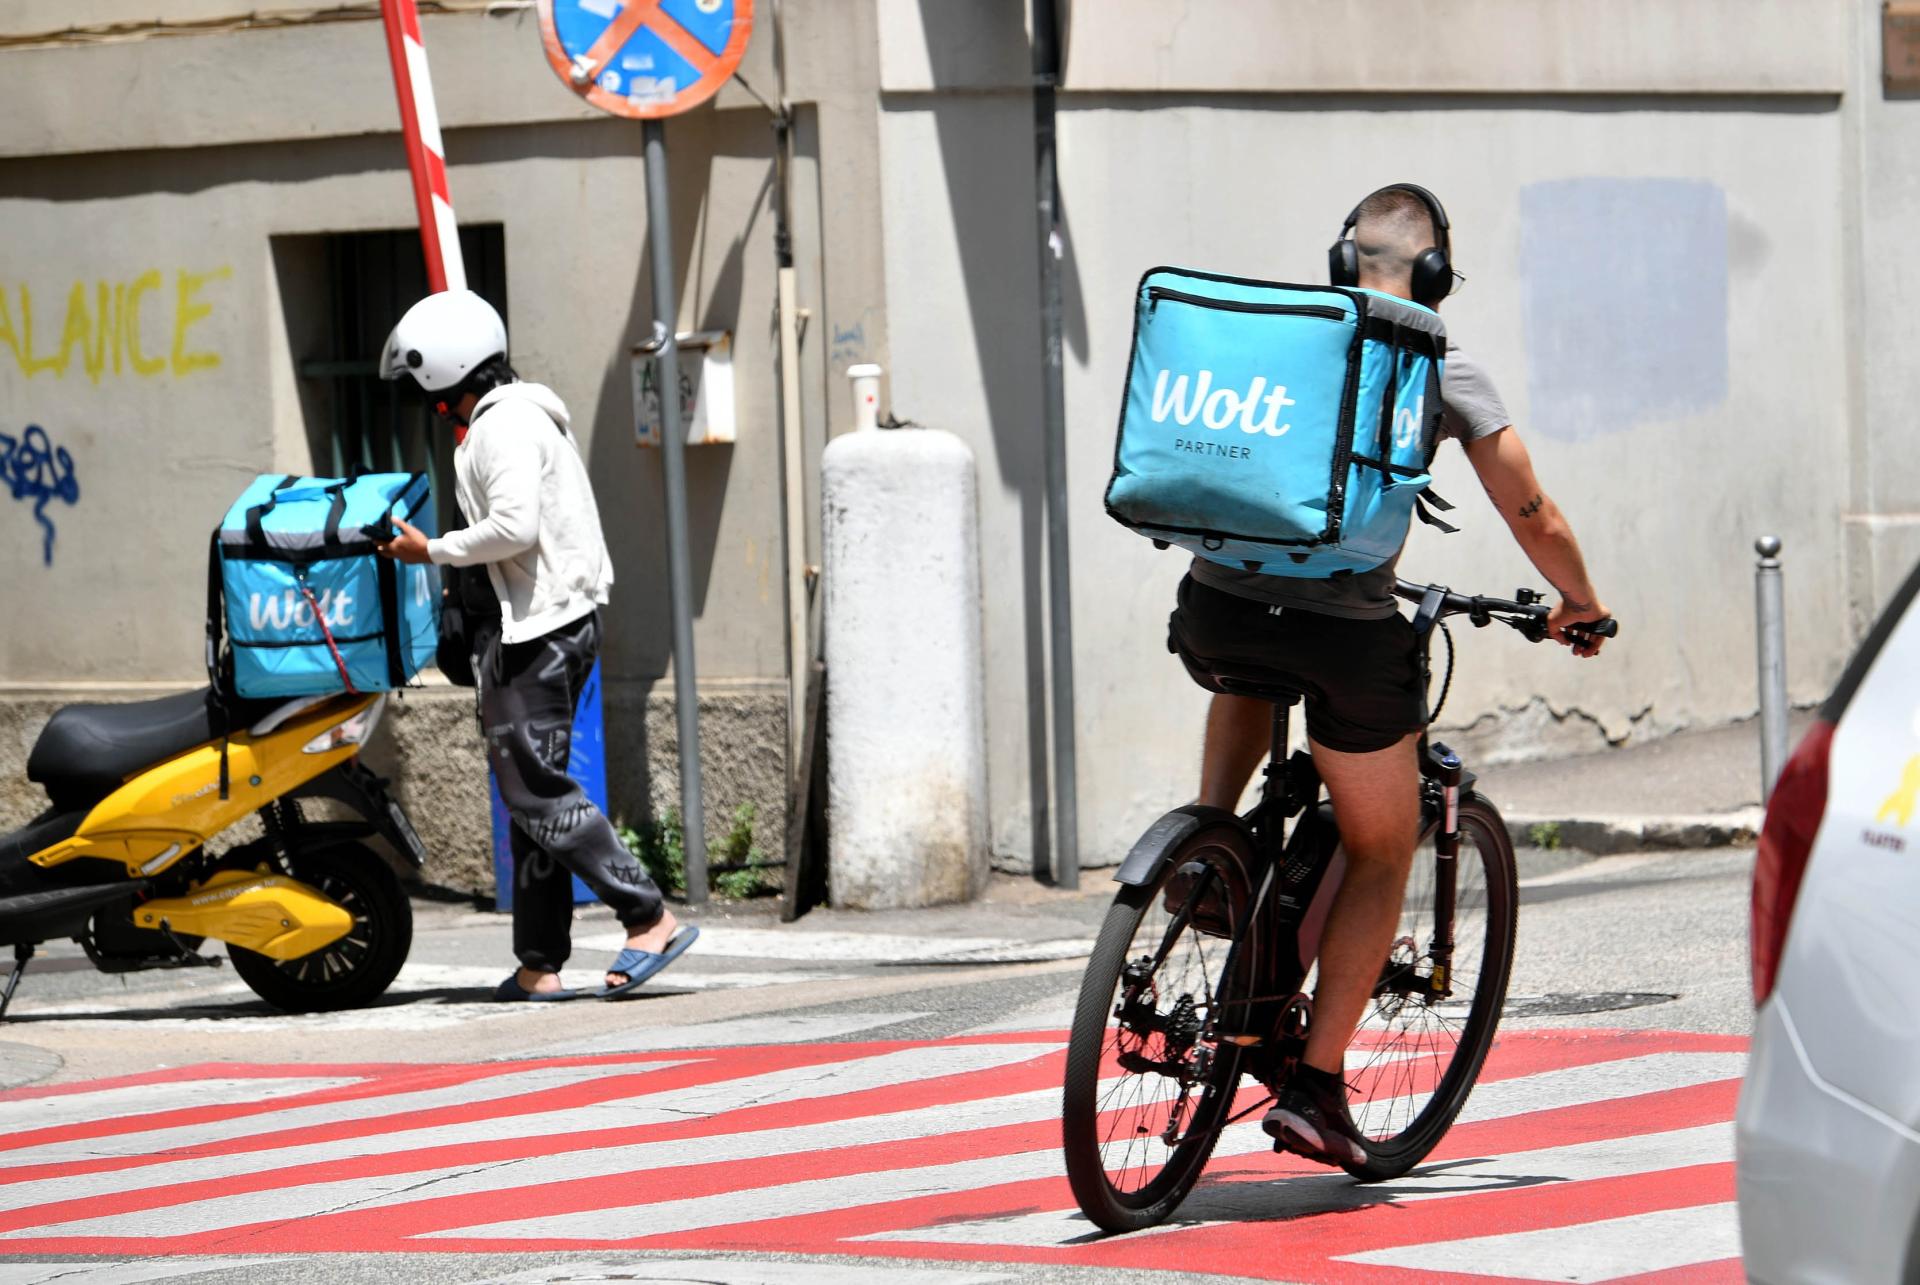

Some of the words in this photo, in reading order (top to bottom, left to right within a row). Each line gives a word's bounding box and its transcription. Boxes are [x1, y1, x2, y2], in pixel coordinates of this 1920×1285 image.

[1151, 369, 1296, 437] Wolt
[1174, 438, 1251, 460] PARTNER
[250, 587, 353, 631] Wolt
